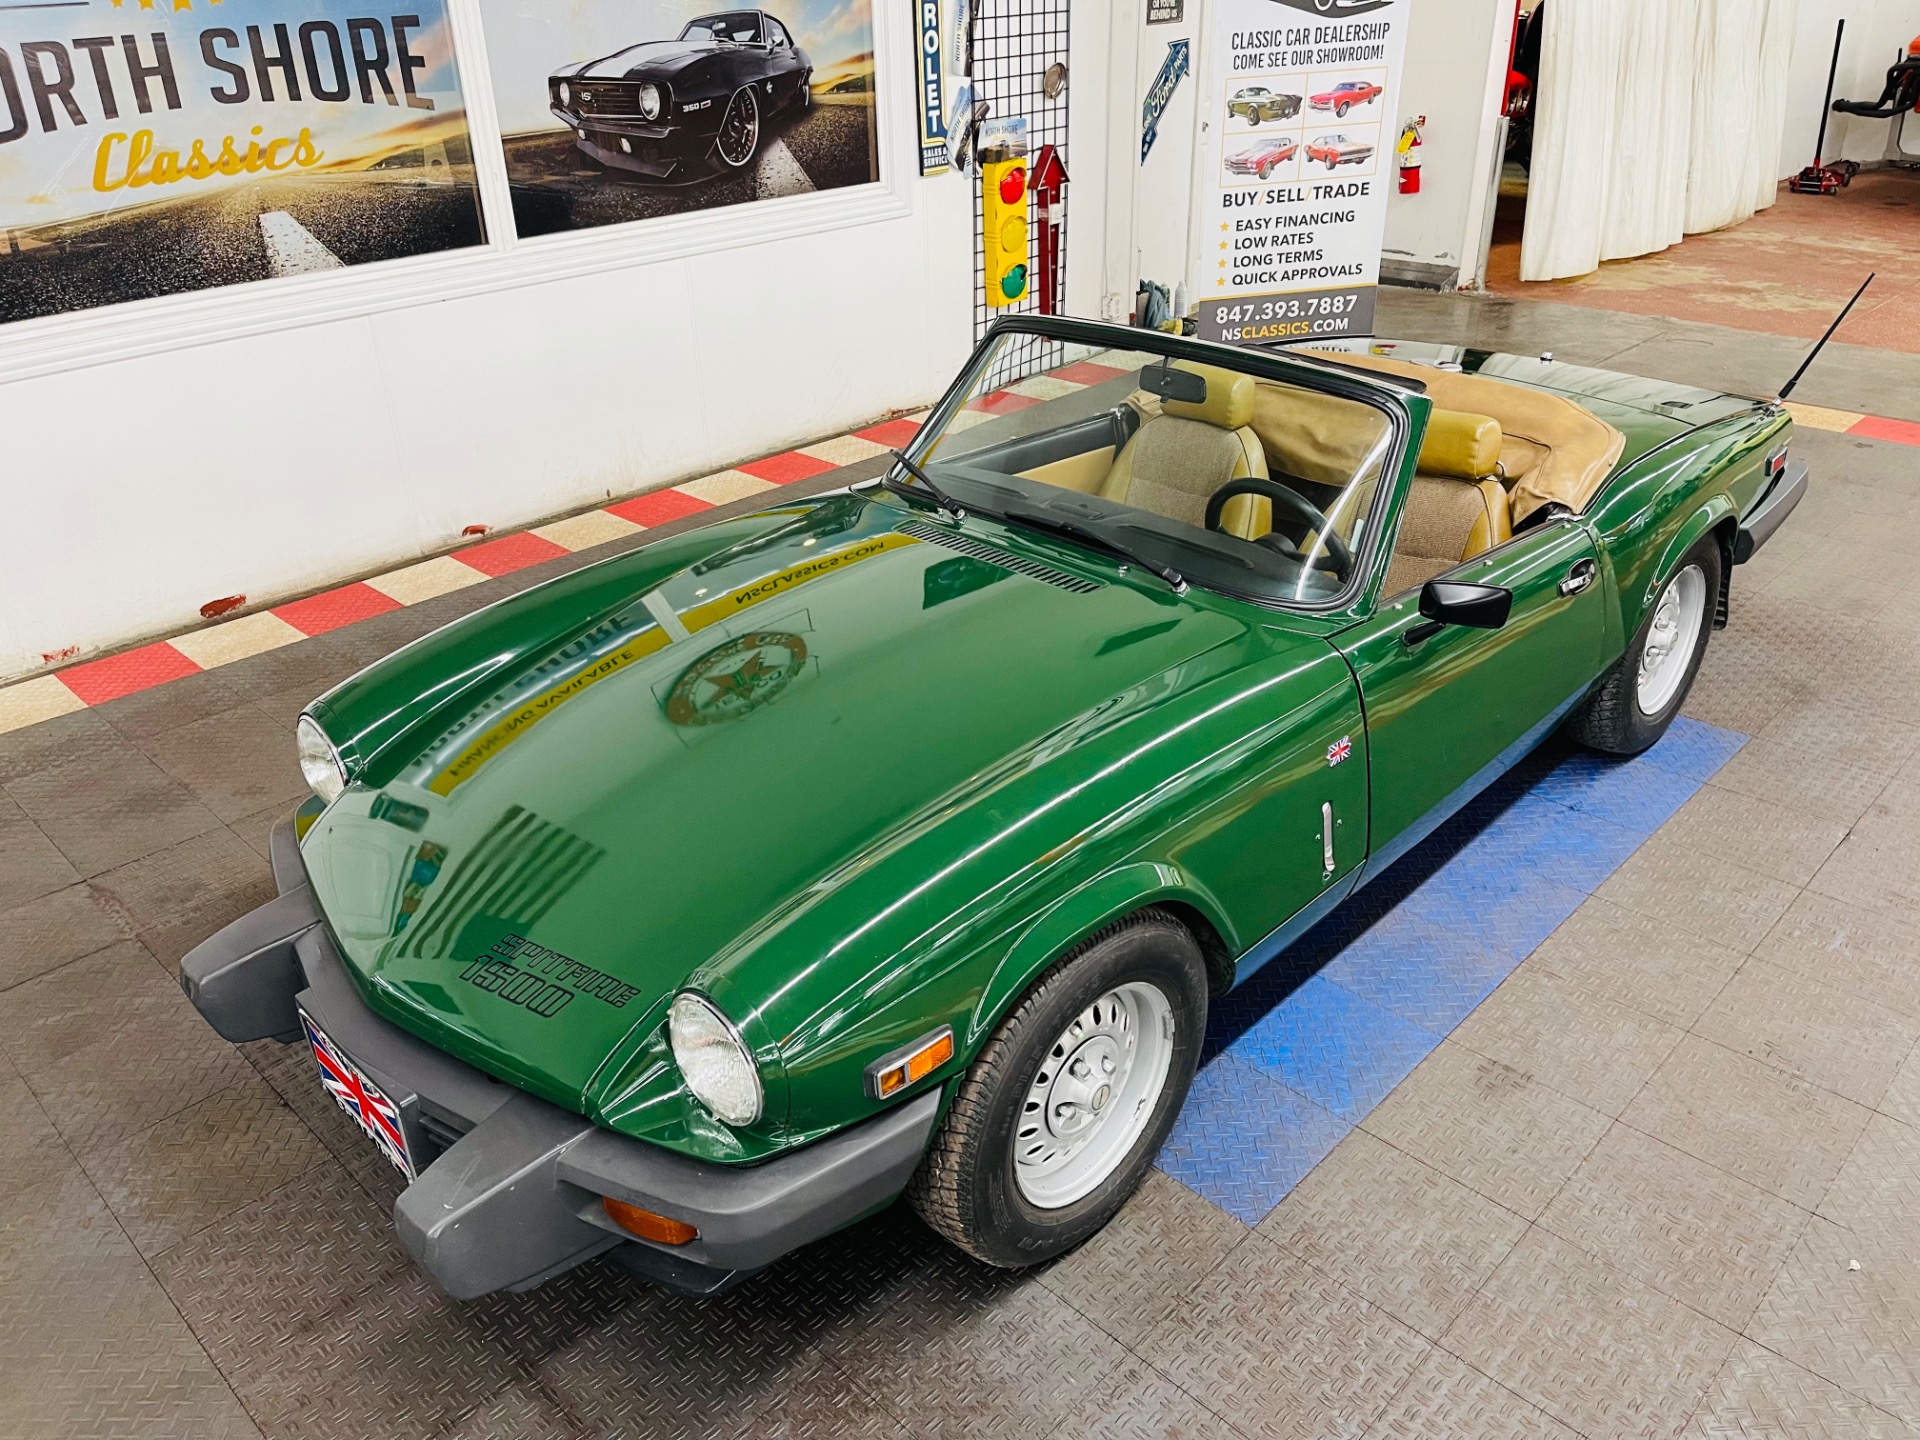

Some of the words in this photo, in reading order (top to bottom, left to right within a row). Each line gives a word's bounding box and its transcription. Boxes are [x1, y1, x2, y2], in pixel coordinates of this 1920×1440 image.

[1150, 8, 1170, 21] BEHIND
[1231, 29, 1282, 51] CLASSIC
[1286, 27, 1310, 46] CAR
[1314, 22, 1391, 44] DEALERSHIP
[199, 15, 435, 111] SHORE
[923, 0, 940, 133] ROLET
[1233, 52, 1264, 70] COME
[1267, 51, 1288, 67] SEE
[1291, 49, 1313, 66] OUR
[1316, 44, 1385, 64] SHOWROOM!
[1151, 64, 1177, 118] Ford
[1173, 45, 1187, 70] PARTS
[92, 125, 325, 193] Classics
[923, 147, 942, 158] SALES
[1236, 217, 1272, 232] EASY
[1275, 210, 1355, 229] FINANCING
[1234, 236, 1268, 250] LOW
[1271, 232, 1314, 247] RATES
[1233, 254, 1273, 268] LONG
[1277, 249, 1323, 265] TERMS
[1232, 271, 1277, 286] QUICK
[1280, 263, 1363, 282] APPROVALS
[1215, 294, 1358, 325] 847.393.7887
[1221, 317, 1349, 342] NSCLASSICS.COM
[491, 933, 641, 1009] SPITFIRE
[459, 954, 575, 1018] 1500
